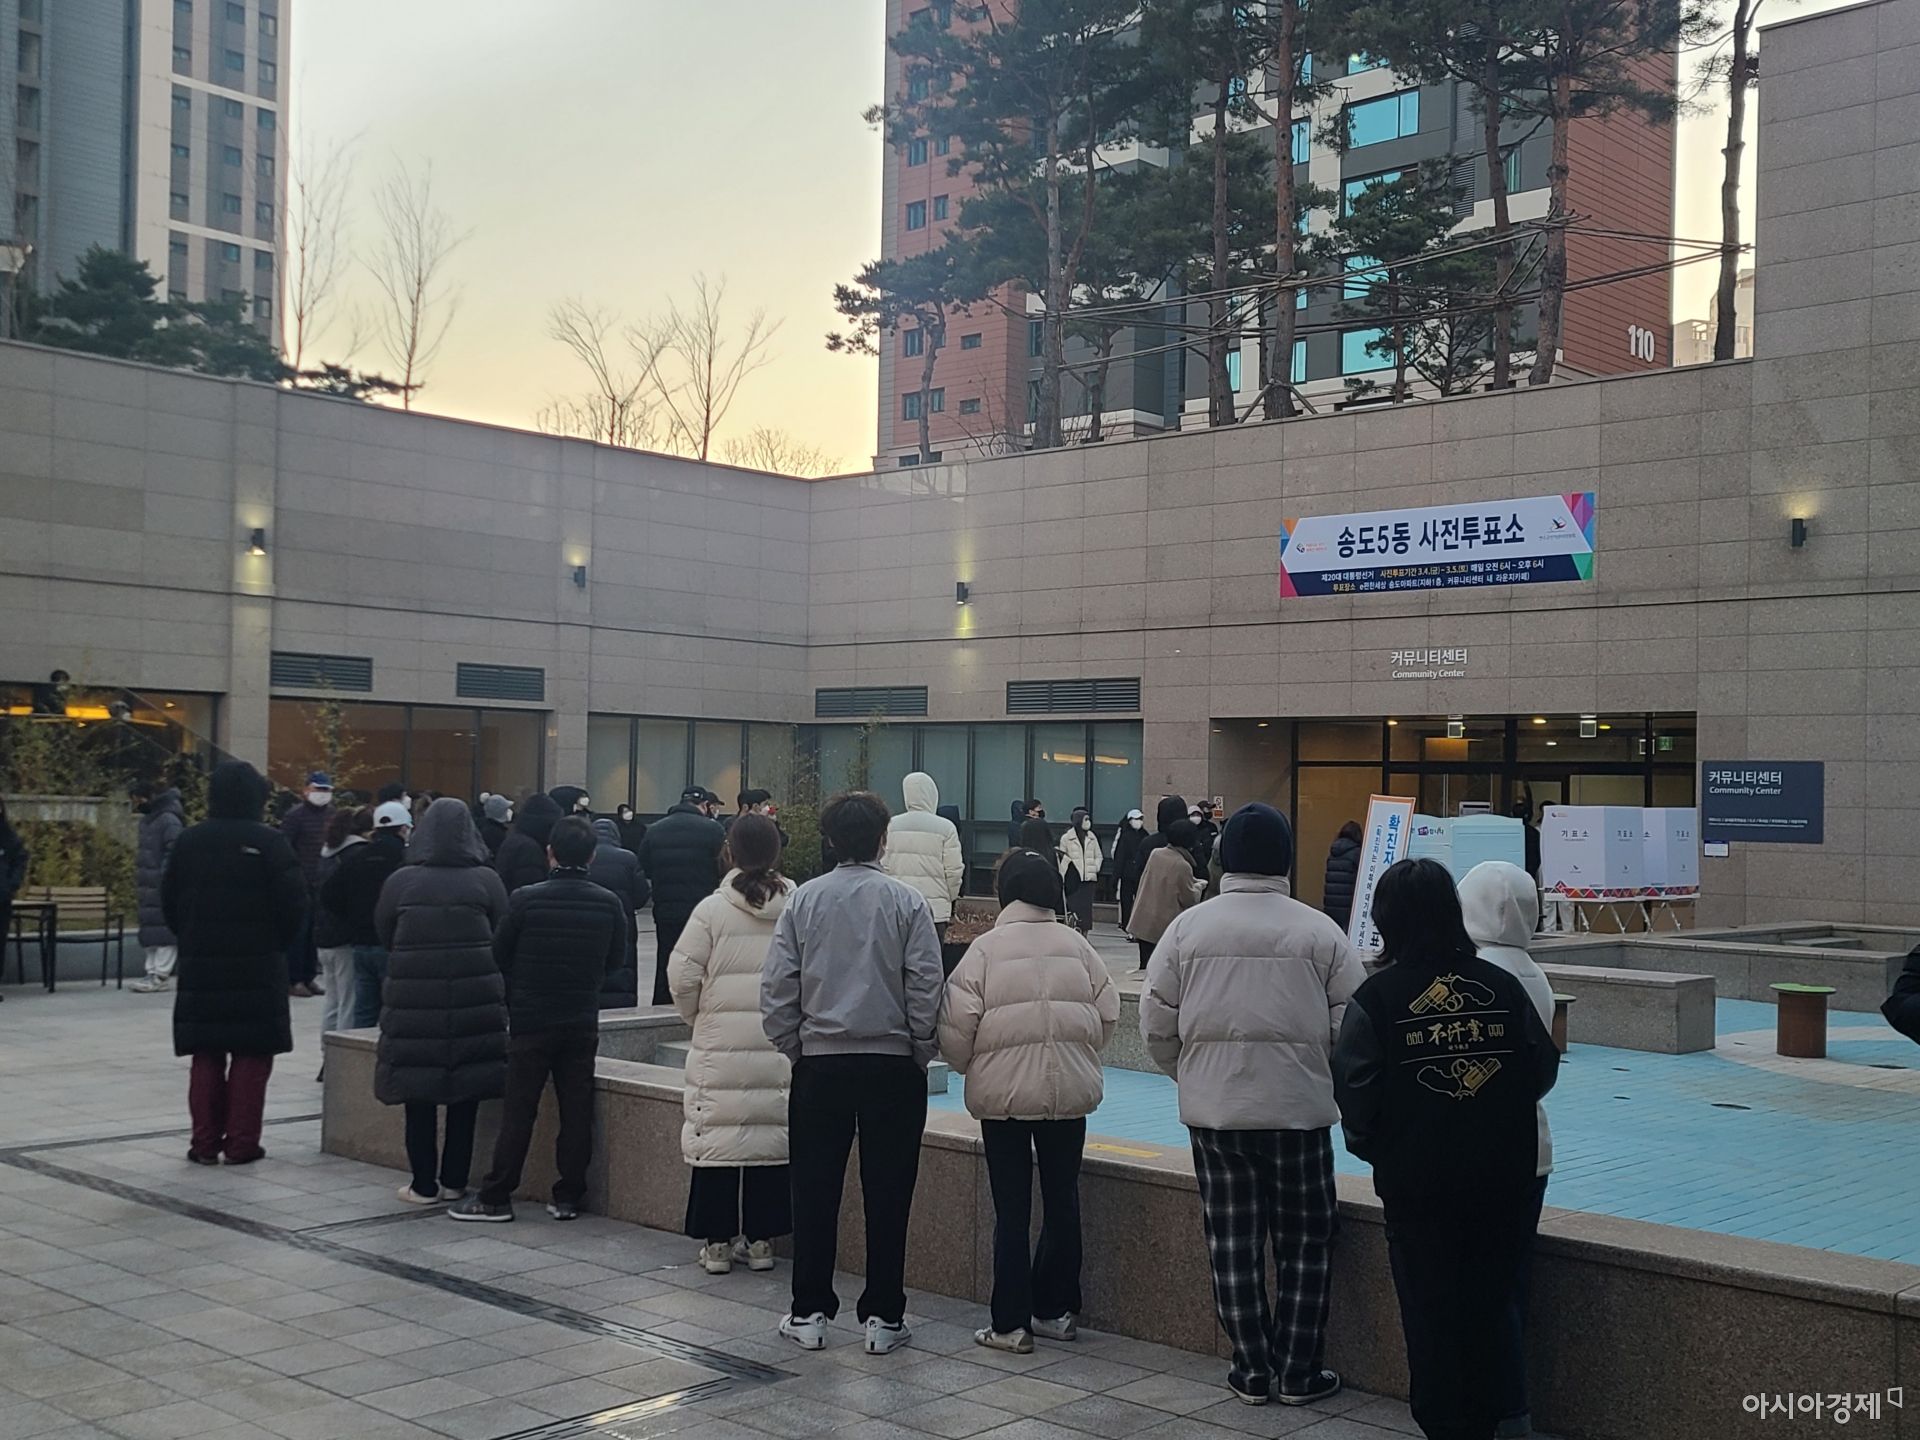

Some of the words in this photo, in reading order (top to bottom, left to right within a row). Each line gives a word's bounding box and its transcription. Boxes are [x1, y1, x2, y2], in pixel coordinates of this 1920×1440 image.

[1628, 325, 1655, 363] 110
[1337, 521, 1411, 559] 송도5동
[1419, 512, 1525, 552] 사전투표소
[1321, 572, 1341, 582] 제20대
[1343, 570, 1375, 581] 대통령선거
[1380, 567, 1418, 578] 사전투표기간
[1471, 563, 1484, 572] 매일
[1485, 561, 1499, 571] 오전
[1500, 560, 1511, 570] 6시
[1518, 560, 1531, 570] 오후
[1533, 559, 1544, 568] 6시
[1447, 574, 1484, 585] 커뮤니티센터
[1486, 573, 1493, 583] 내
[1390, 649, 1468, 666] 커뮤니티센터
[1392, 670, 1437, 679] Community
[1438, 669, 1466, 678] Center
[1708, 771, 1782, 785] 커뮤니티센터
[1709, 786, 1754, 796] Community
[1755, 787, 1782, 795] Center
[1383, 814, 1401, 866] 확진자
